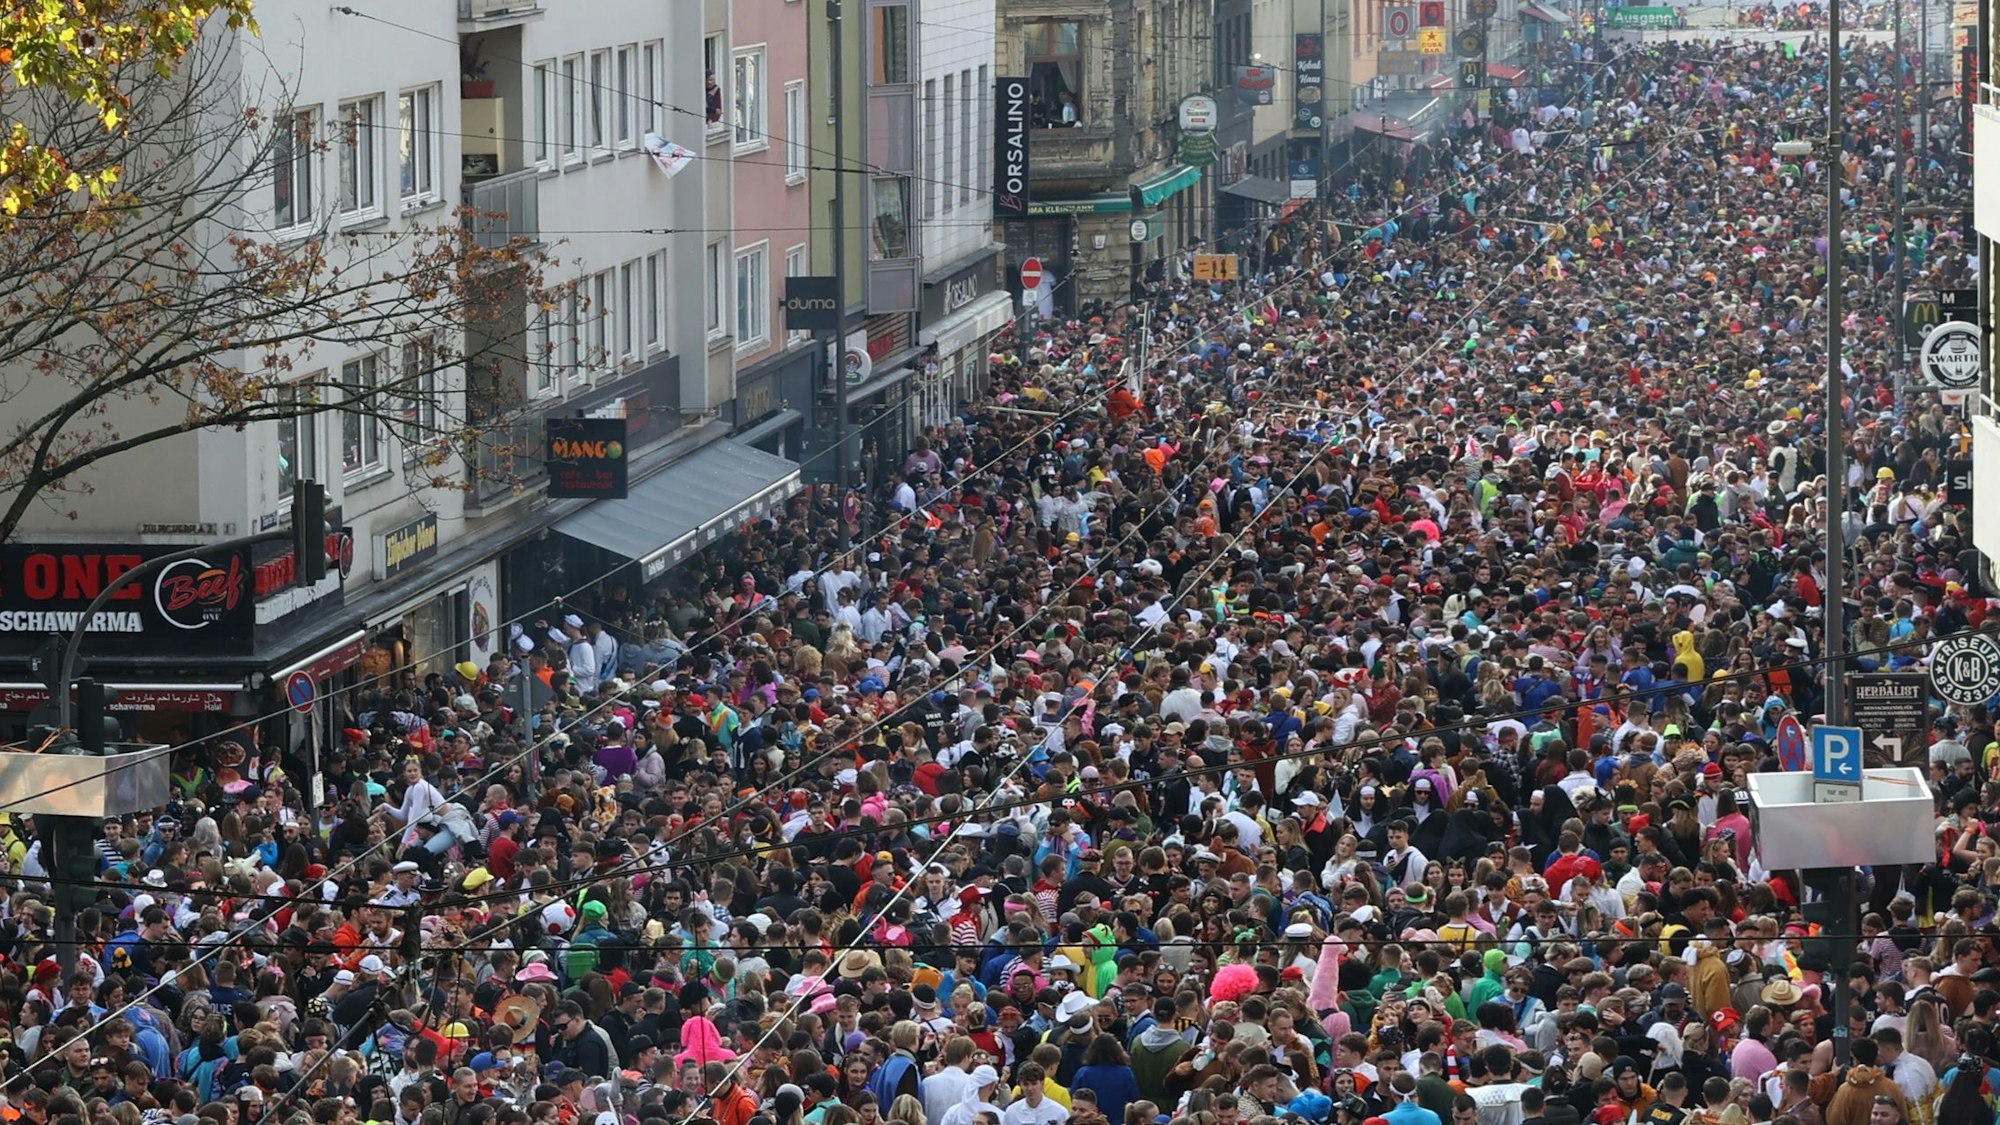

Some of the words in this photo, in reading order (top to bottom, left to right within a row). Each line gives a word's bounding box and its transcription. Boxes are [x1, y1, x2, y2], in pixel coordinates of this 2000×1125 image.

[1615, 12, 1672, 25] Ausgang
[788, 297, 836, 310] duma
[24, 553, 143, 600] ONE
[162, 554, 243, 611] Beef
[0, 610, 143, 633] SCHAWARMA
[1936, 637, 1998, 665] FRISEUR
[1954, 657, 1981, 682] K&B
[1856, 685, 1921, 699] HERBALIST
[1936, 675, 1998, 702] 9383320
[109, 703, 156, 711] schawarma
[1824, 734, 1850, 773] P
